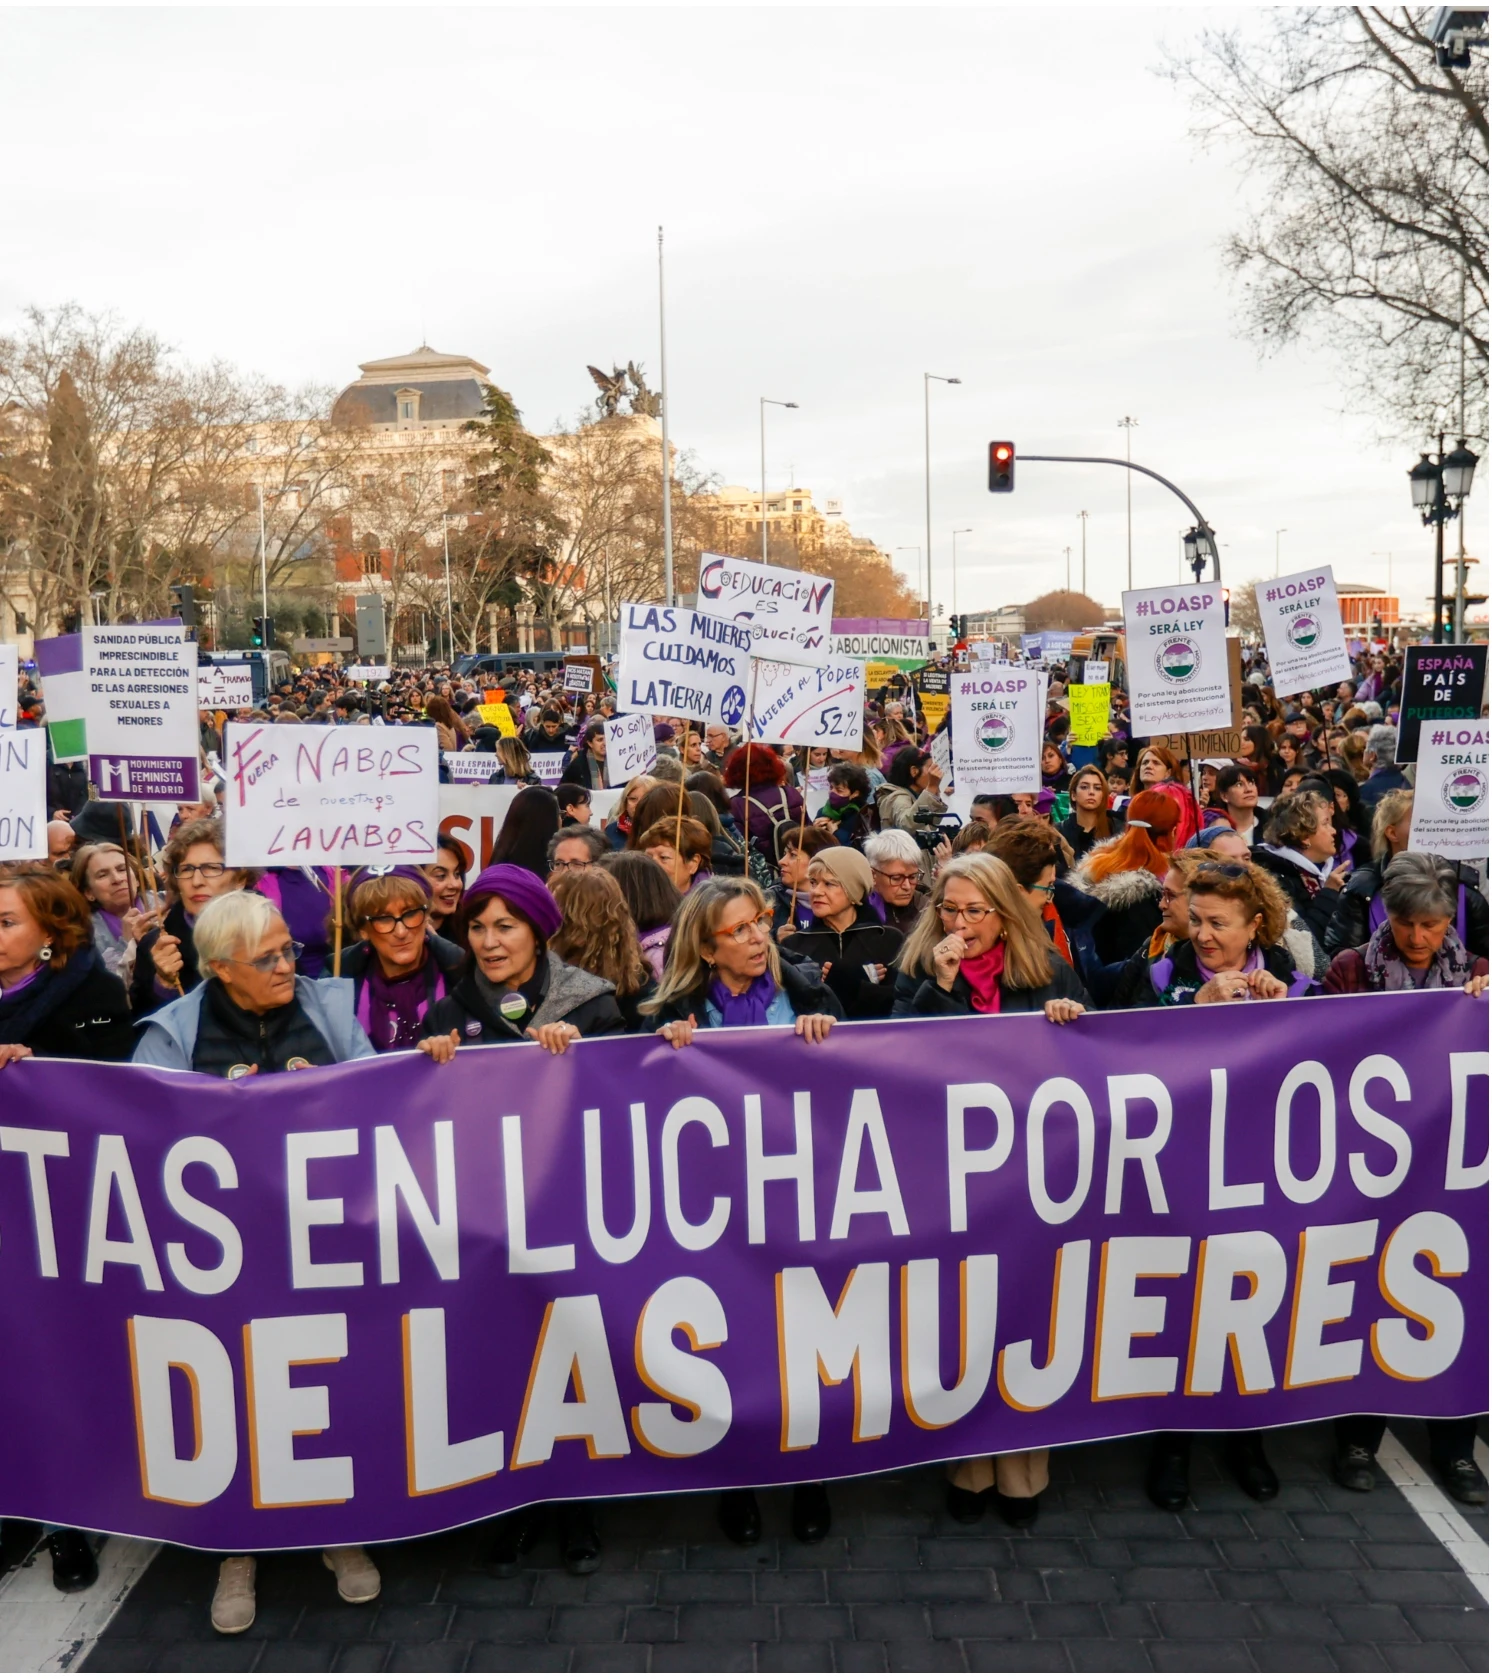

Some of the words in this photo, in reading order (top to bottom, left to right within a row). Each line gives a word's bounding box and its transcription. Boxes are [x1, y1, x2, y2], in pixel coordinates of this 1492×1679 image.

[1266, 576, 1325, 602] #LOASP
[755, 600, 778, 613] ES
[1136, 594, 1213, 616] #LOASP
[1279, 600, 1302, 616] SERÁ
[1304, 597, 1321, 609] LEY
[628, 606, 677, 633] LAS
[690, 612, 751, 653] MUJERES
[1149, 619, 1180, 635] SERÁ
[1184, 620, 1205, 633] LEY
[93, 635, 137, 644] SANIDAD
[138, 633, 182, 645] PÚBLICA
[836, 637, 923, 657] ABOLICIONISTA
[99, 651, 179, 661] IMPRESCINDIBLE
[643, 641, 736, 676] CUIDAMOS
[1417, 654, 1474, 670] ESPAÑA
[90, 667, 117, 677] PARA
[118, 668, 132, 677] LA
[134, 666, 190, 678] DETECCIÓN
[213, 666, 224, 676] A
[1422, 670, 1466, 686] PAÍS
[91, 684, 104, 692] DE
[105, 684, 125, 693] LAS
[127, 684, 189, 694] AGRESIONES
[960, 679, 1028, 695] #LOASP
[1071, 688, 1088, 698] LEY
[1137, 690, 1150, 699] Por
[1151, 690, 1165, 698] una
[1165, 688, 1177, 697] ley
[1178, 685, 1222, 695] abolicionista
[1434, 689, 1452, 701] DE
[109, 700, 161, 710] SEXUALES
[163, 701, 170, 710] A
[745, 686, 794, 739] MUJERES
[798, 675, 811, 690] AL
[816, 664, 860, 693] PODER
[971, 699, 996, 711] SERÁ
[999, 700, 1018, 710] LEY
[1134, 700, 1146, 709] del
[1146, 698, 1175, 707] sistema
[1176, 693, 1225, 706] prostitucional
[117, 716, 163, 726] MENORES
[1407, 706, 1475, 720] PUTEROS
[814, 706, 858, 737] 52%
[610, 724, 623, 741] YO
[130, 760, 182, 769] MOVIMIENTO
[468, 759, 497, 768] ESPAÑA
[1440, 752, 1472, 764] SERÁ
[1475, 754, 1489, 764] LE
[232, 728, 279, 807] FUERA
[296, 728, 423, 784] NABOS
[131, 771, 183, 783] FEMINISTA
[132, 785, 143, 793] DE
[147, 785, 184, 794] MADRID
[273, 787, 300, 808] de
[267, 820, 435, 855] LAVABOS
[0, 1126, 243, 1295] TAS
[286, 1121, 460, 1288] EN
[502, 1088, 911, 1275] LUCHA
[946, 1073, 1174, 1233] POR
[1208, 1053, 1412, 1211] LOS
[127, 1312, 355, 1509] DE
[401, 1276, 733, 1497] LAS
[774, 1210, 1470, 1452] MUJERES
